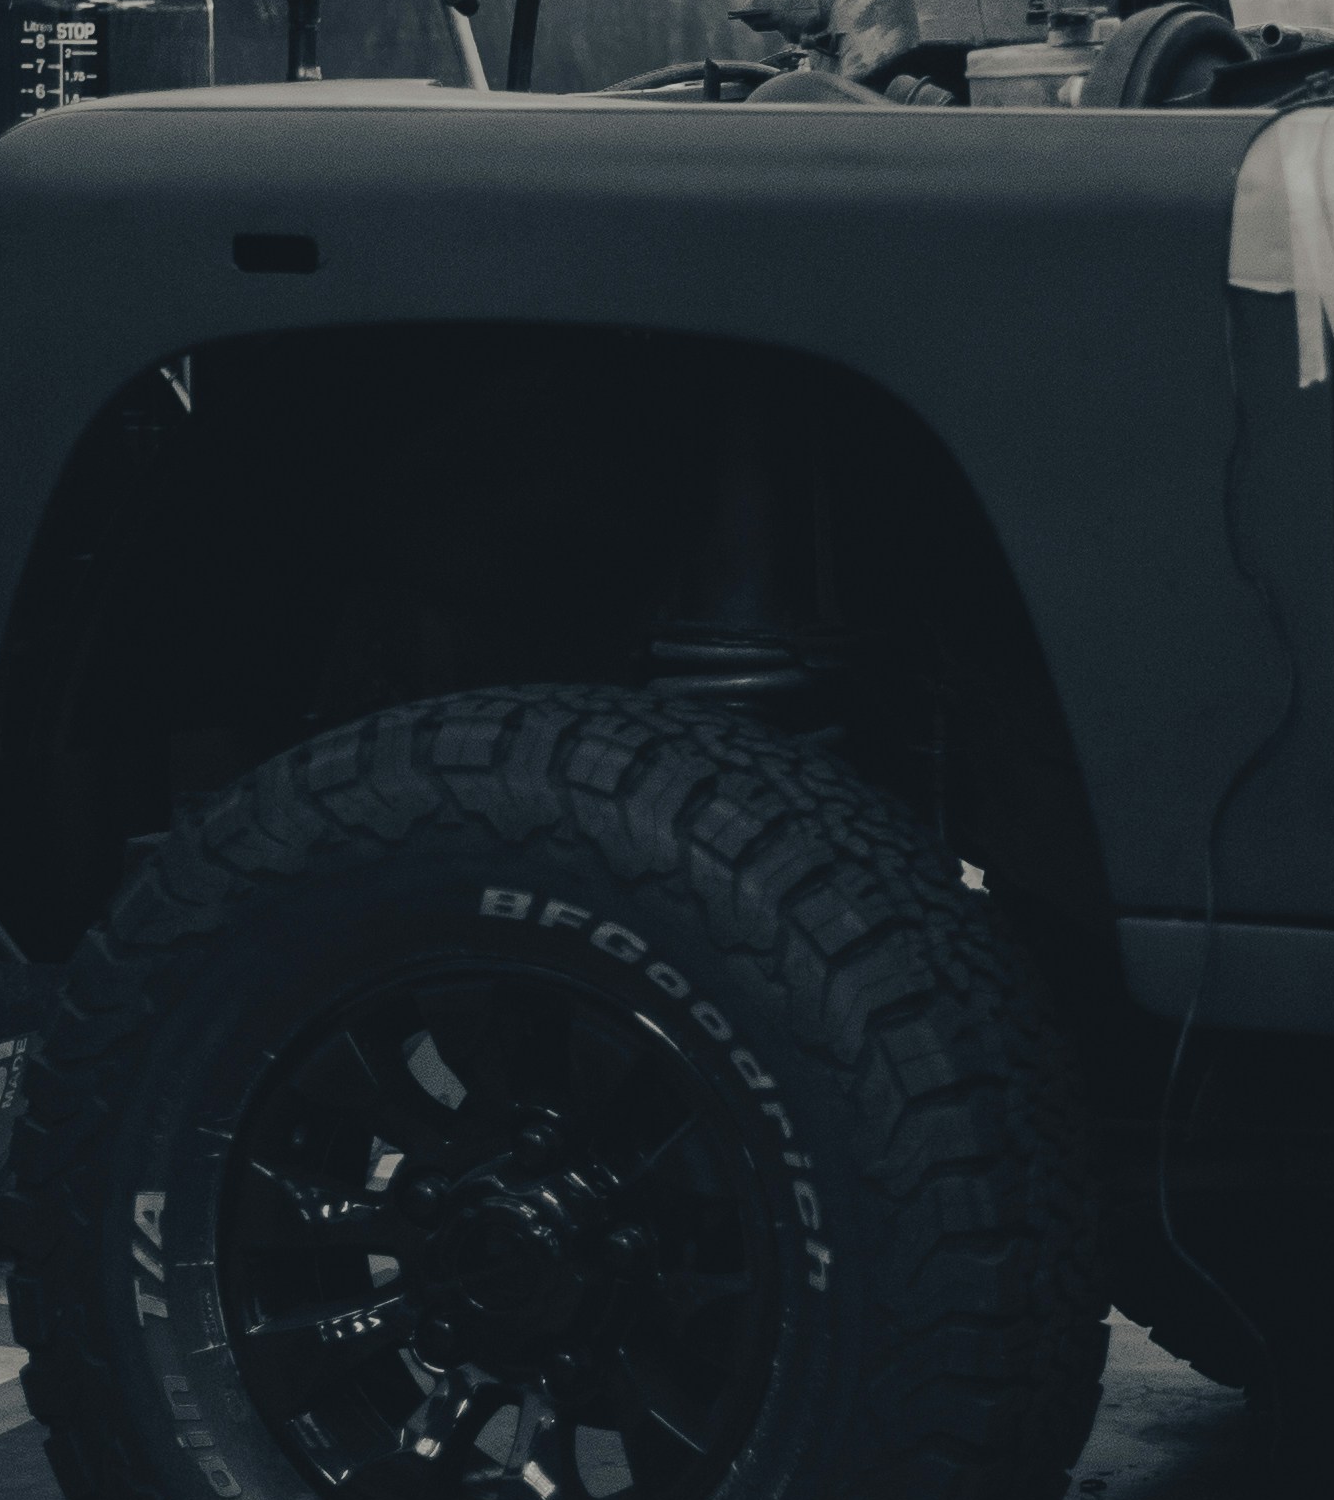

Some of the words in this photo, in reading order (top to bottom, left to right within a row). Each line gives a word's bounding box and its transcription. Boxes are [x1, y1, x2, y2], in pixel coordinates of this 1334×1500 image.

[56, 22, 96, 39] STOP
[35, 33, 46, 50] 8
[35, 58, 46, 74] 7
[35, 83, 46, 100] 6
[480, 887, 834, 1292] BFGoodrich
[131, 1191, 169, 1328] T/A
